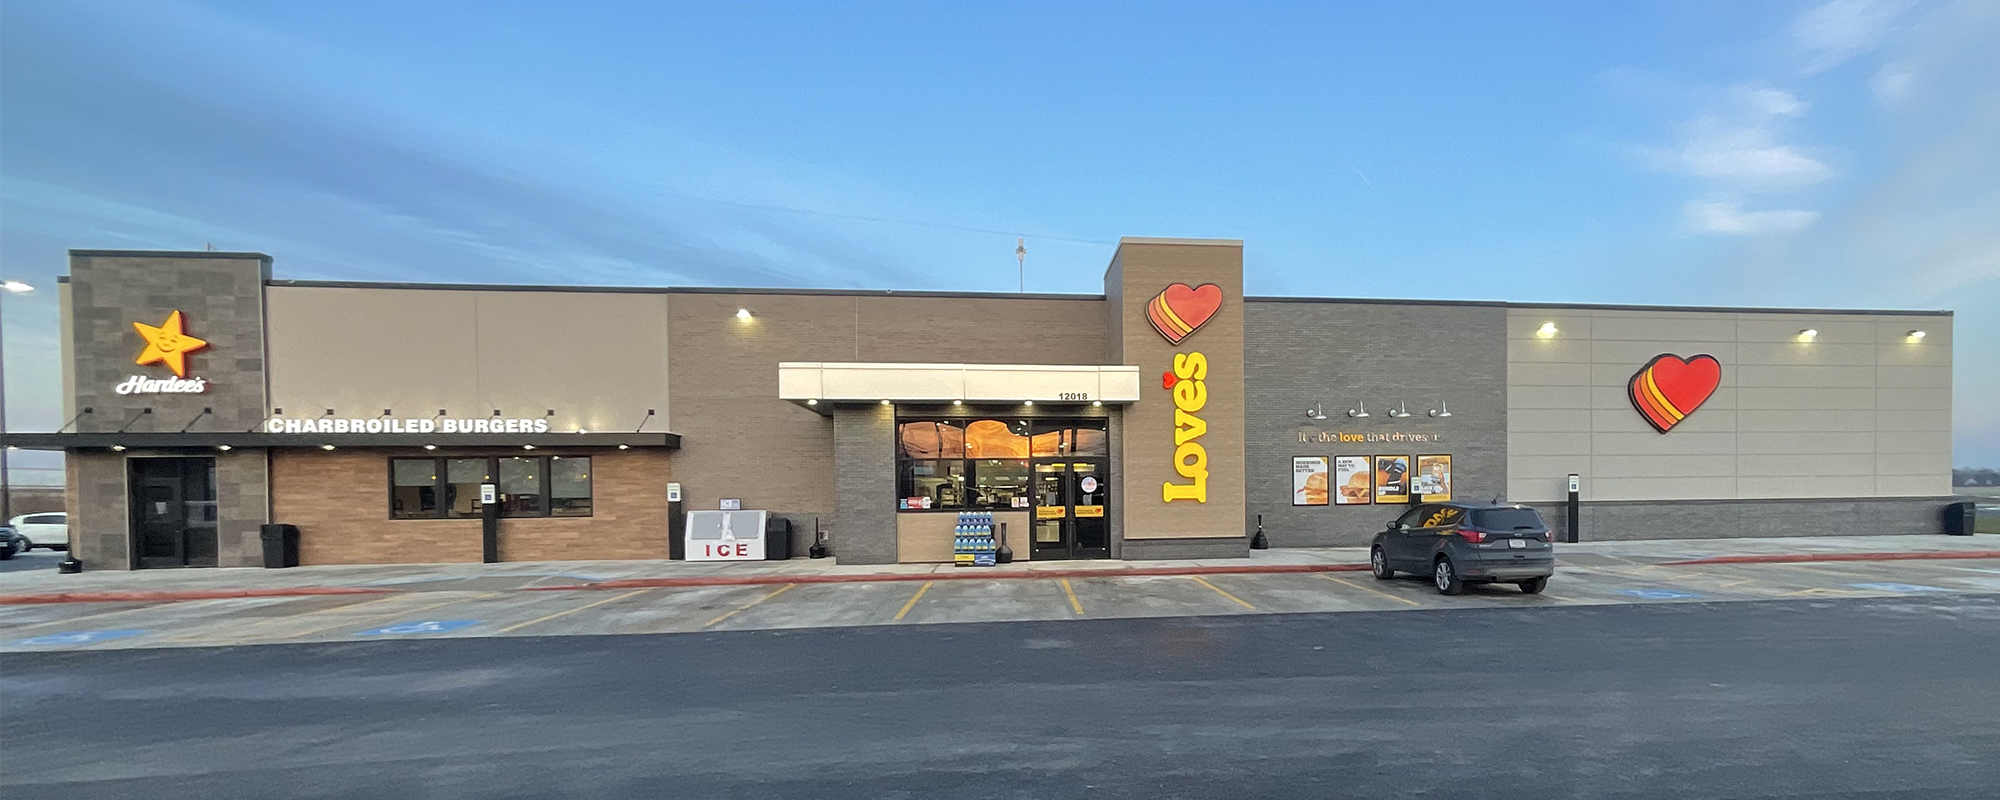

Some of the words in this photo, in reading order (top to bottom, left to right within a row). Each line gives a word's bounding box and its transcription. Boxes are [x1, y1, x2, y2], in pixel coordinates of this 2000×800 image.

[116, 375, 206, 395] Hardee's
[1058, 392, 1088, 400] 12018
[268, 418, 435, 434] CHARBROILED
[443, 418, 548, 434] BURGERS
[1318, 431, 1337, 442] the
[1339, 431, 1364, 442] love
[1366, 431, 1390, 442] that
[1392, 431, 1428, 442] drives
[706, 543, 748, 557] ICE
